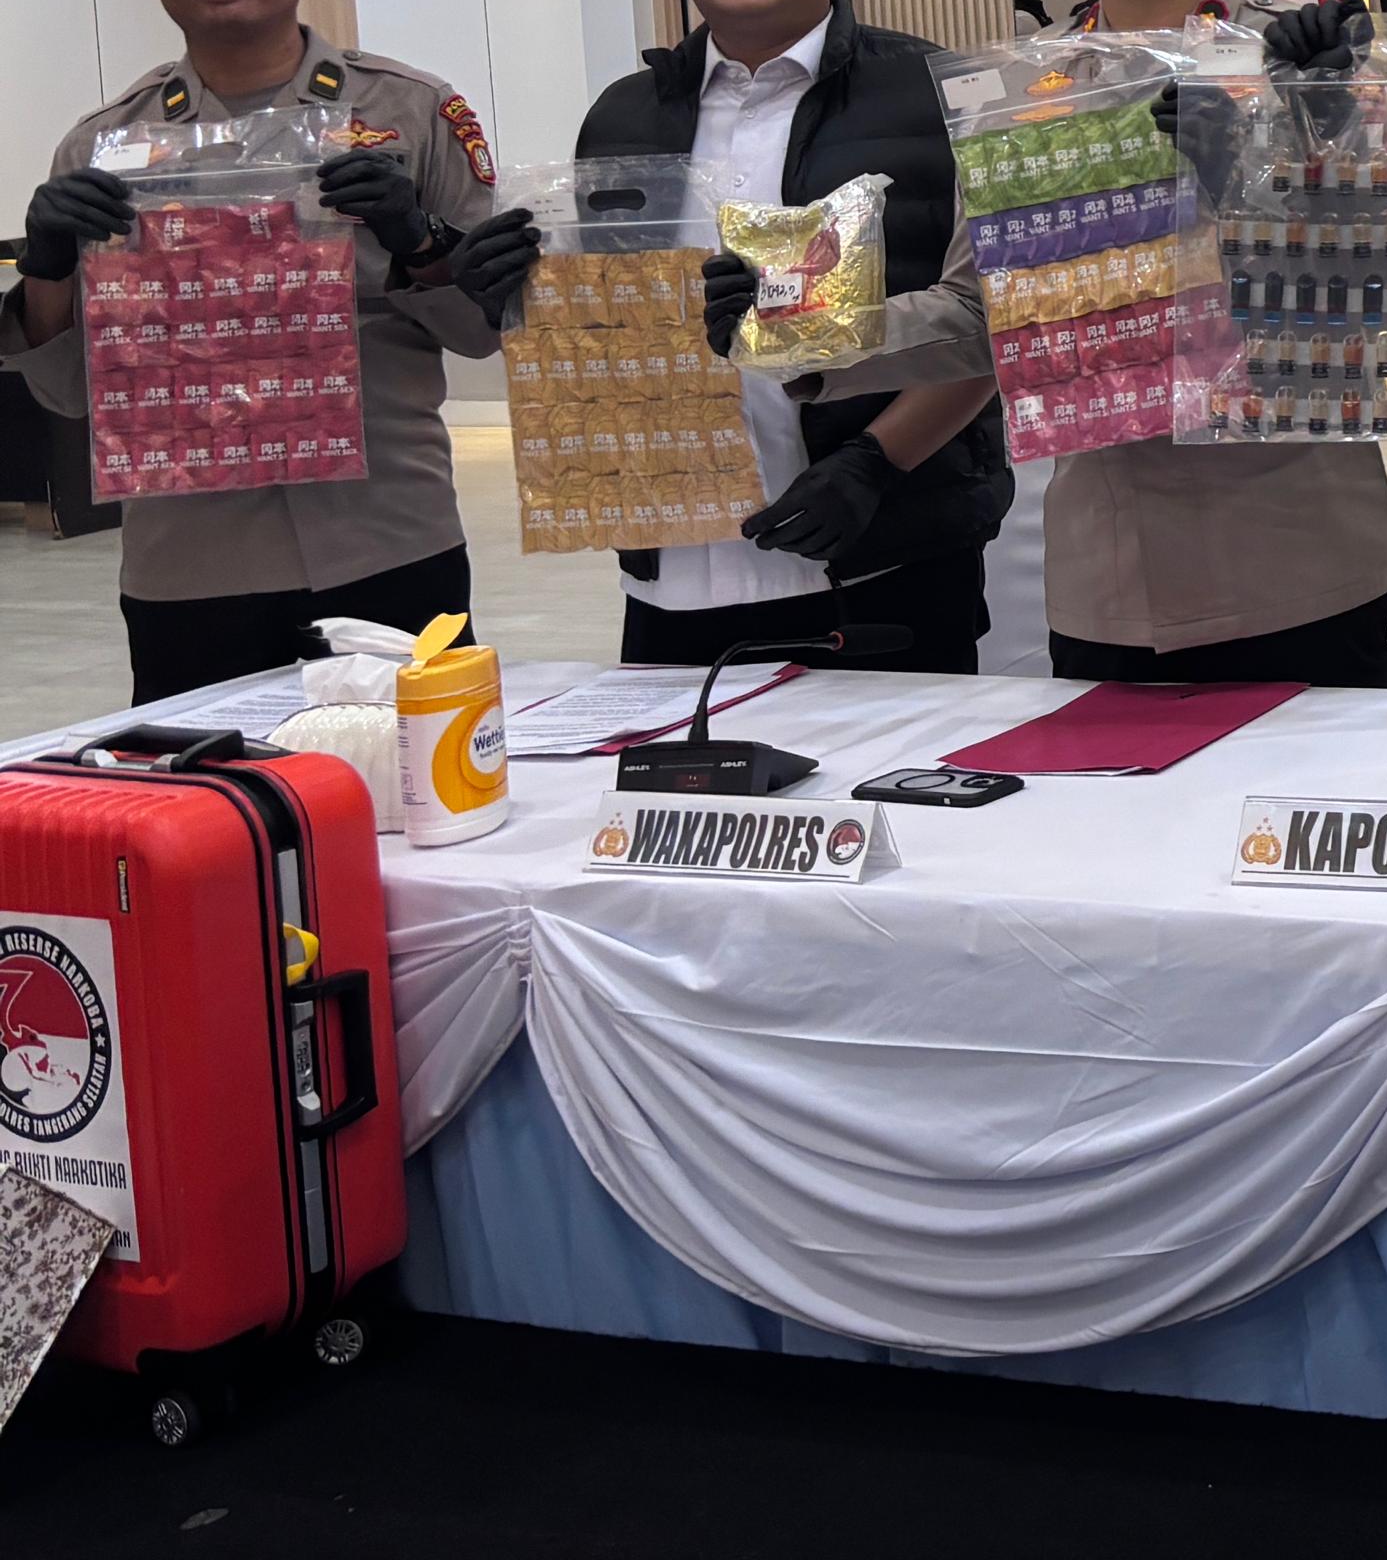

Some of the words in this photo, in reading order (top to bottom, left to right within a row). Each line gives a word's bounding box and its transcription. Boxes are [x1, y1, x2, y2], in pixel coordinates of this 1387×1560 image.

[474, 726, 505, 752] Wetti
[627, 809, 825, 872] WAKAPOLRES
[6, 932, 60, 963] RESERSE
[59, 954, 105, 1029] NARKOBA
[0, 1106, 30, 1134] OLRES
[33, 1102, 87, 1136] TANGERANG
[84, 1054, 107, 1109] SELATAN
[54, 1155, 127, 1189] NARKOTIKA
